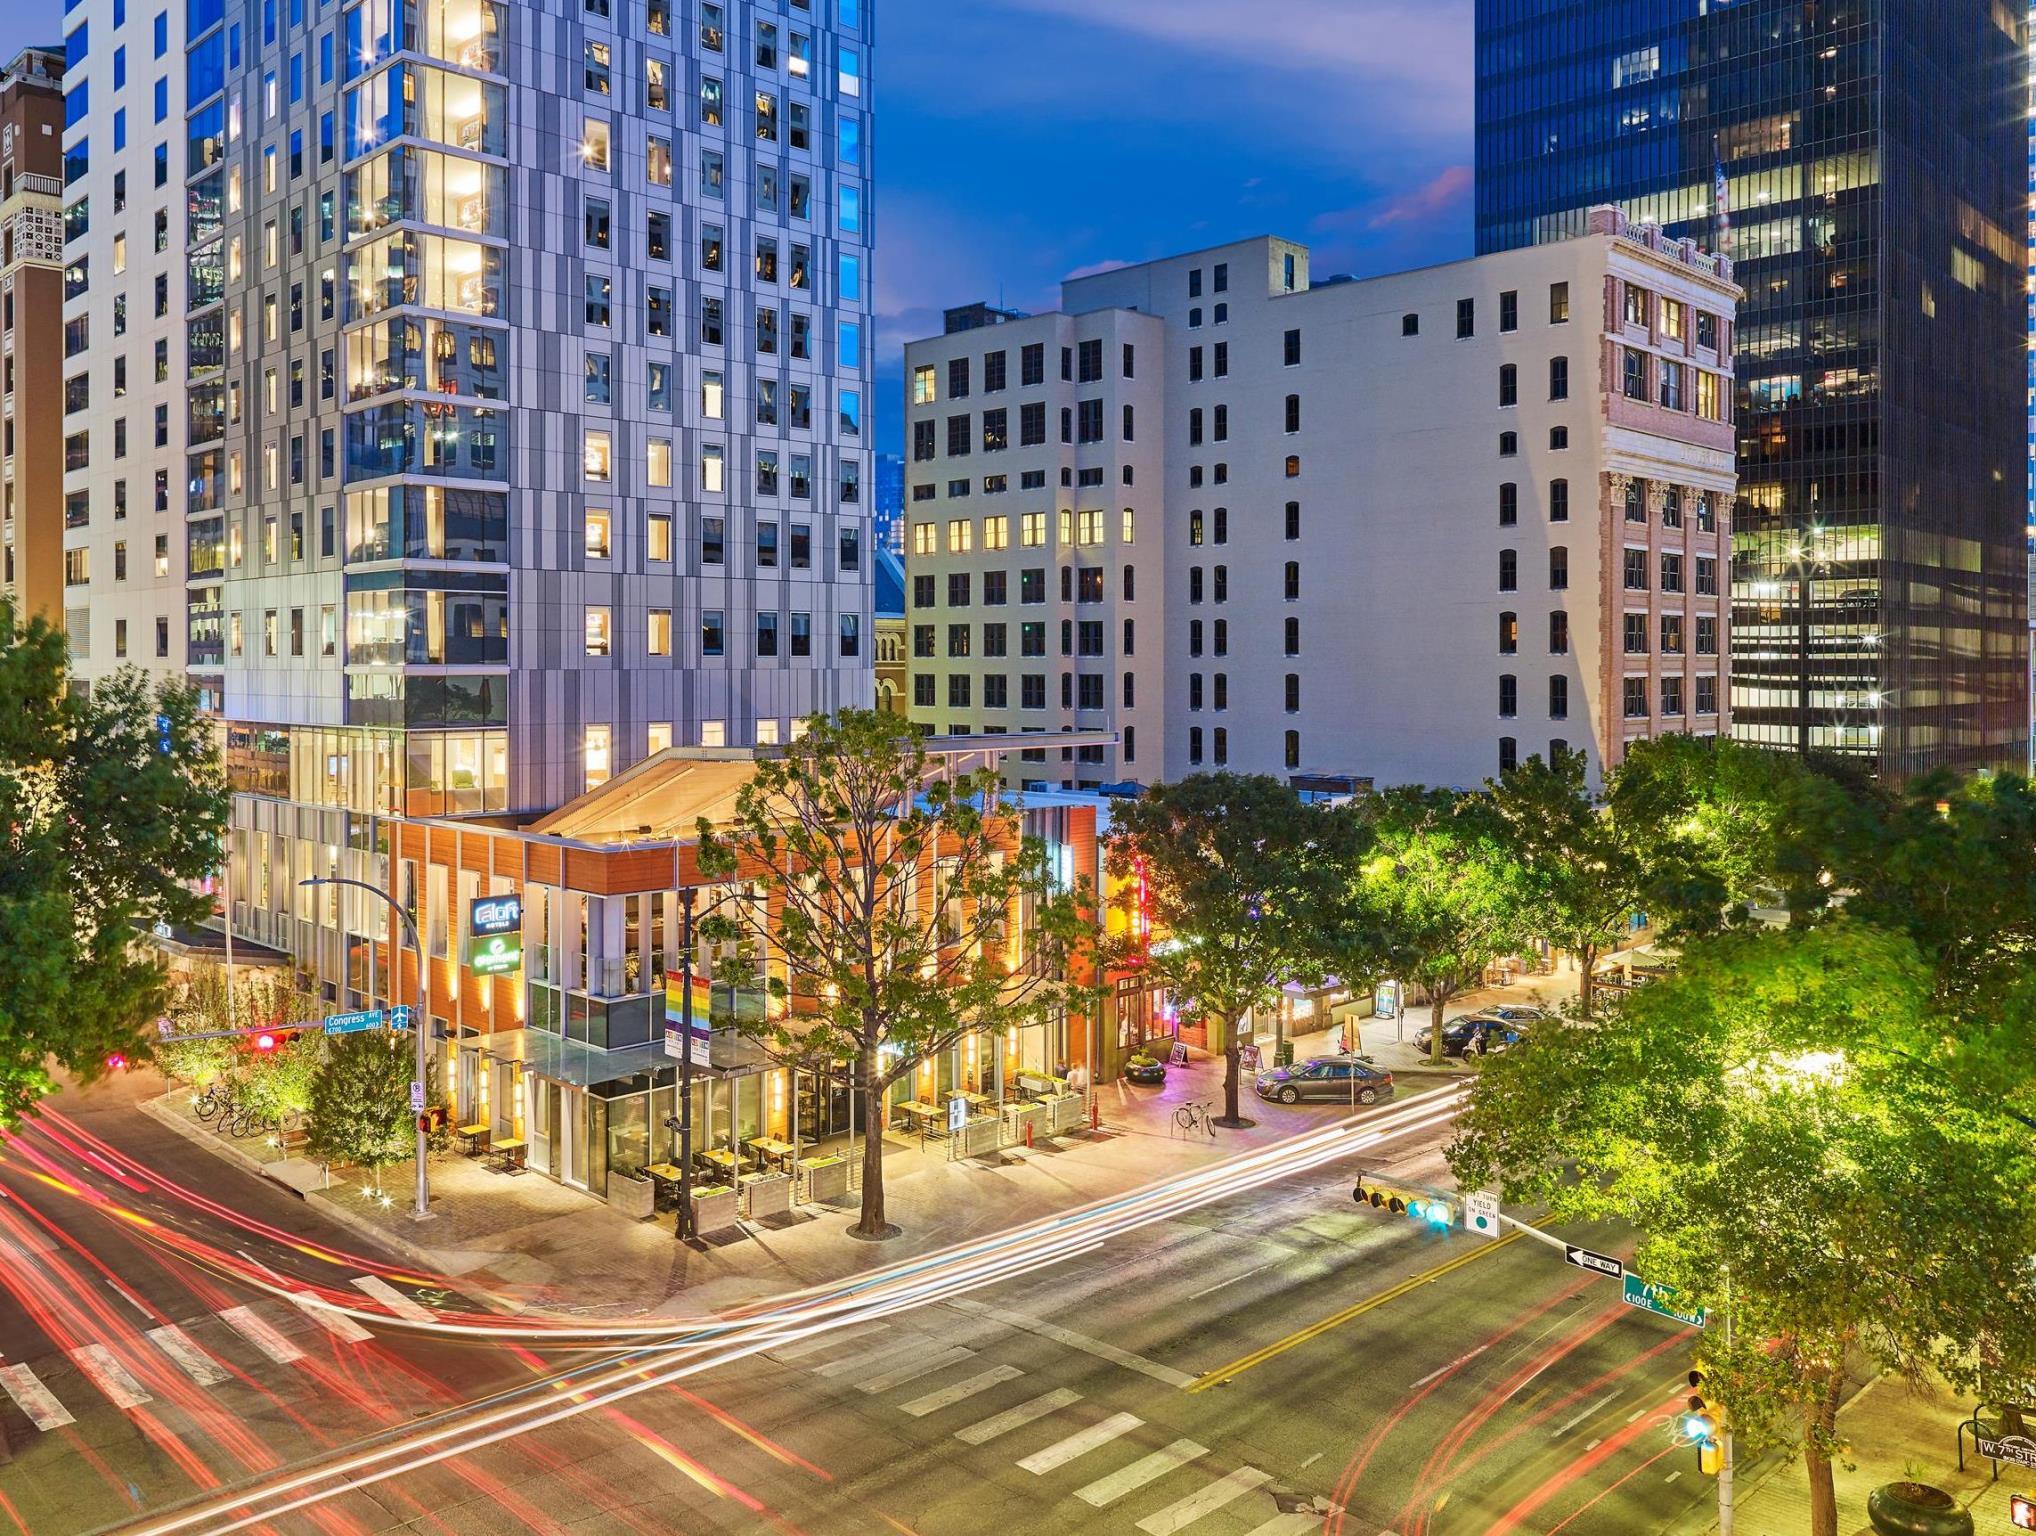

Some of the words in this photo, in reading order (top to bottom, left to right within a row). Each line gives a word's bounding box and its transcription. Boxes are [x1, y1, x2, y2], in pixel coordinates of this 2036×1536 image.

[475, 902, 519, 924] aloft
[329, 1015, 365, 1026] Congress
[1473, 1199, 1491, 1209] YIELD
[1479, 1209, 1496, 1218] GREEN
[1582, 1255, 1598, 1267] ONE
[1599, 1260, 1616, 1271] WAY
[1983, 1442, 1996, 1454] W.
[1998, 1444, 2014, 1455] 7TH
